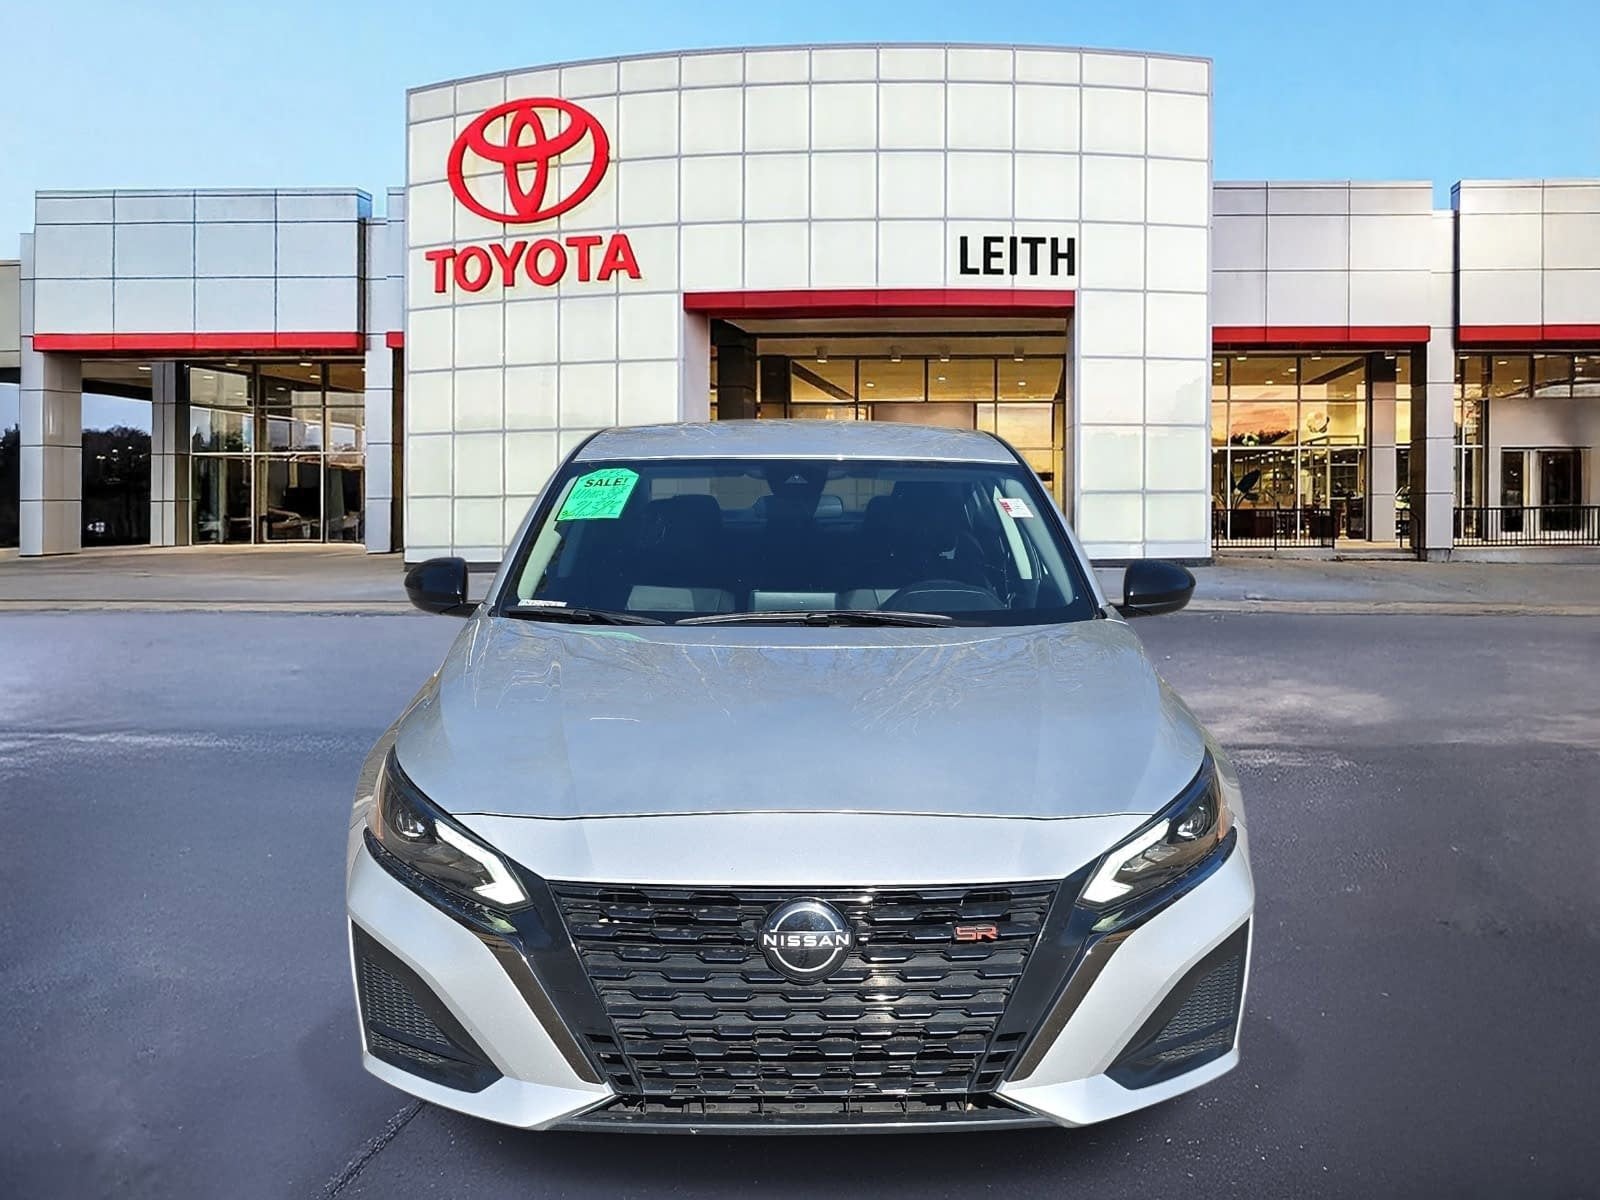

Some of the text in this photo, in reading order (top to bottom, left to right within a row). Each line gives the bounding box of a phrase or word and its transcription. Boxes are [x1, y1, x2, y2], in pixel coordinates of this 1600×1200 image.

[425, 233, 641, 293] TOYOTA
[959, 236, 1076, 276] LEITH
[584, 477, 628, 487] SALE!
[763, 933, 850, 948] NISSAN
[954, 925, 998, 943] SR
